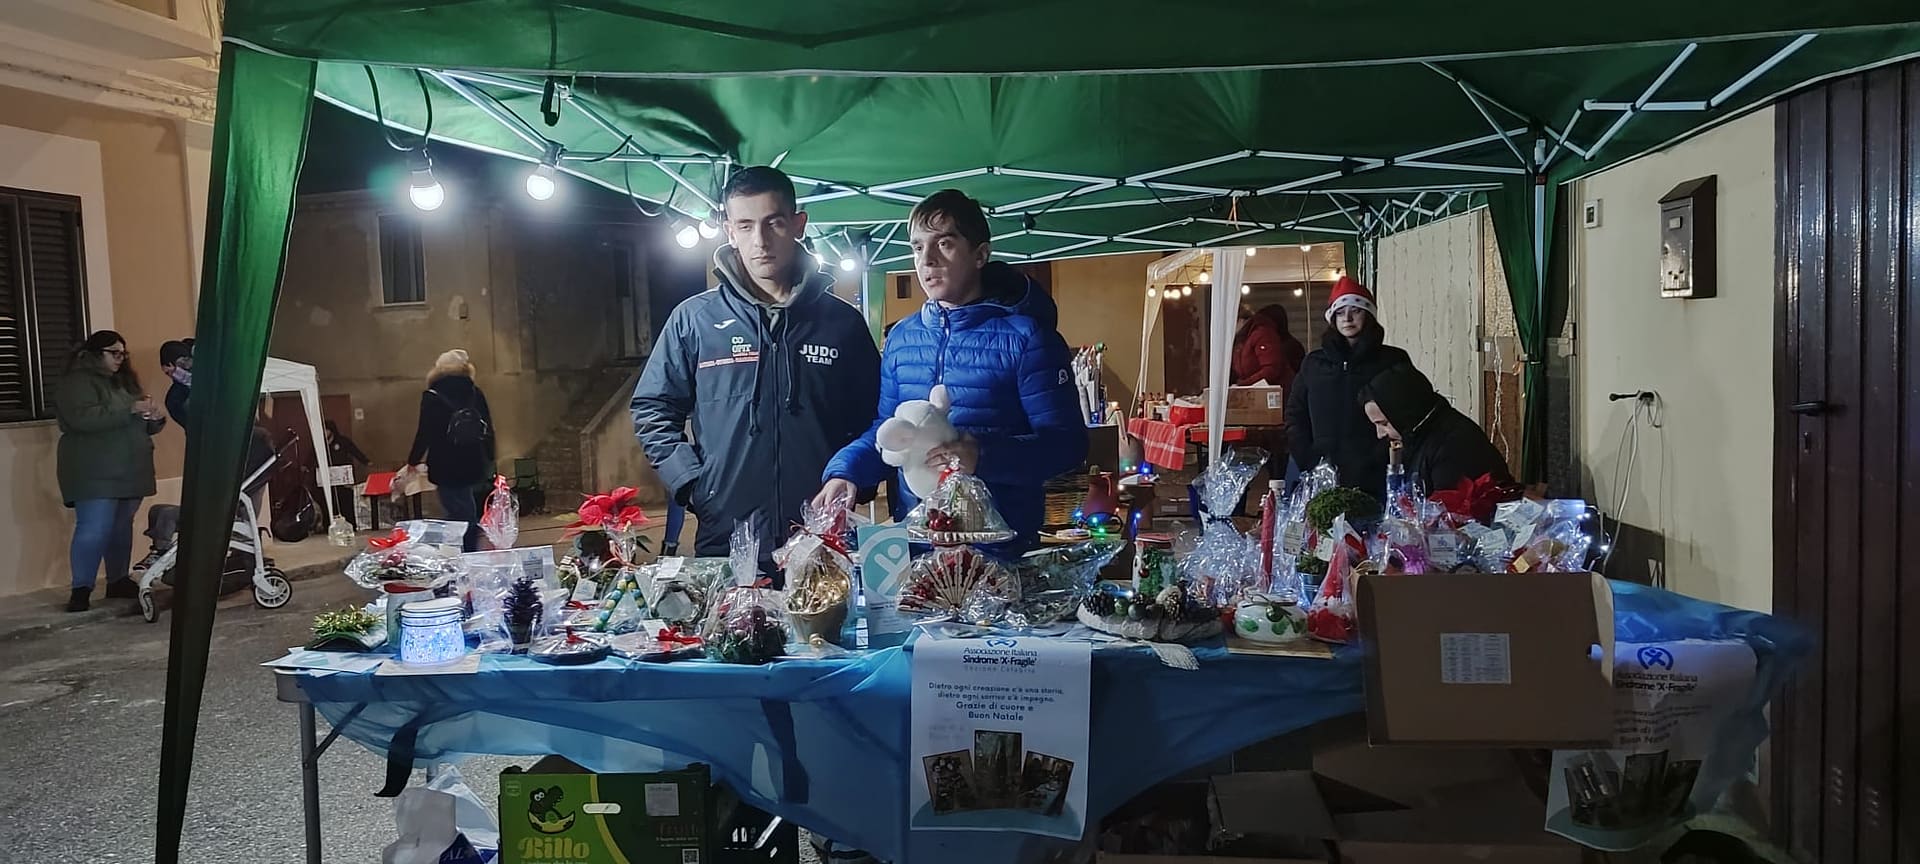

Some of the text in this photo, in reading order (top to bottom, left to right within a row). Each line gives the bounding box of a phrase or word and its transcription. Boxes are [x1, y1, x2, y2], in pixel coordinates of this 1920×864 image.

[798, 344, 838, 358] JUDO
[805, 355, 832, 365] TEAM
[963, 647, 1038, 657] Associazione Italiana
[962, 655, 999, 665] Sindrome
[928, 682, 952, 690] Dietro
[953, 683, 971, 693] ogni
[972, 685, 1009, 693] creazione
[937, 692, 961, 700] dietro
[962, 692, 979, 702] ogni
[955, 701, 986, 710] Grazie
[988, 701, 998, 710] di
[999, 704, 1025, 712] cuore
[968, 711, 1024, 721] Buon Natale
